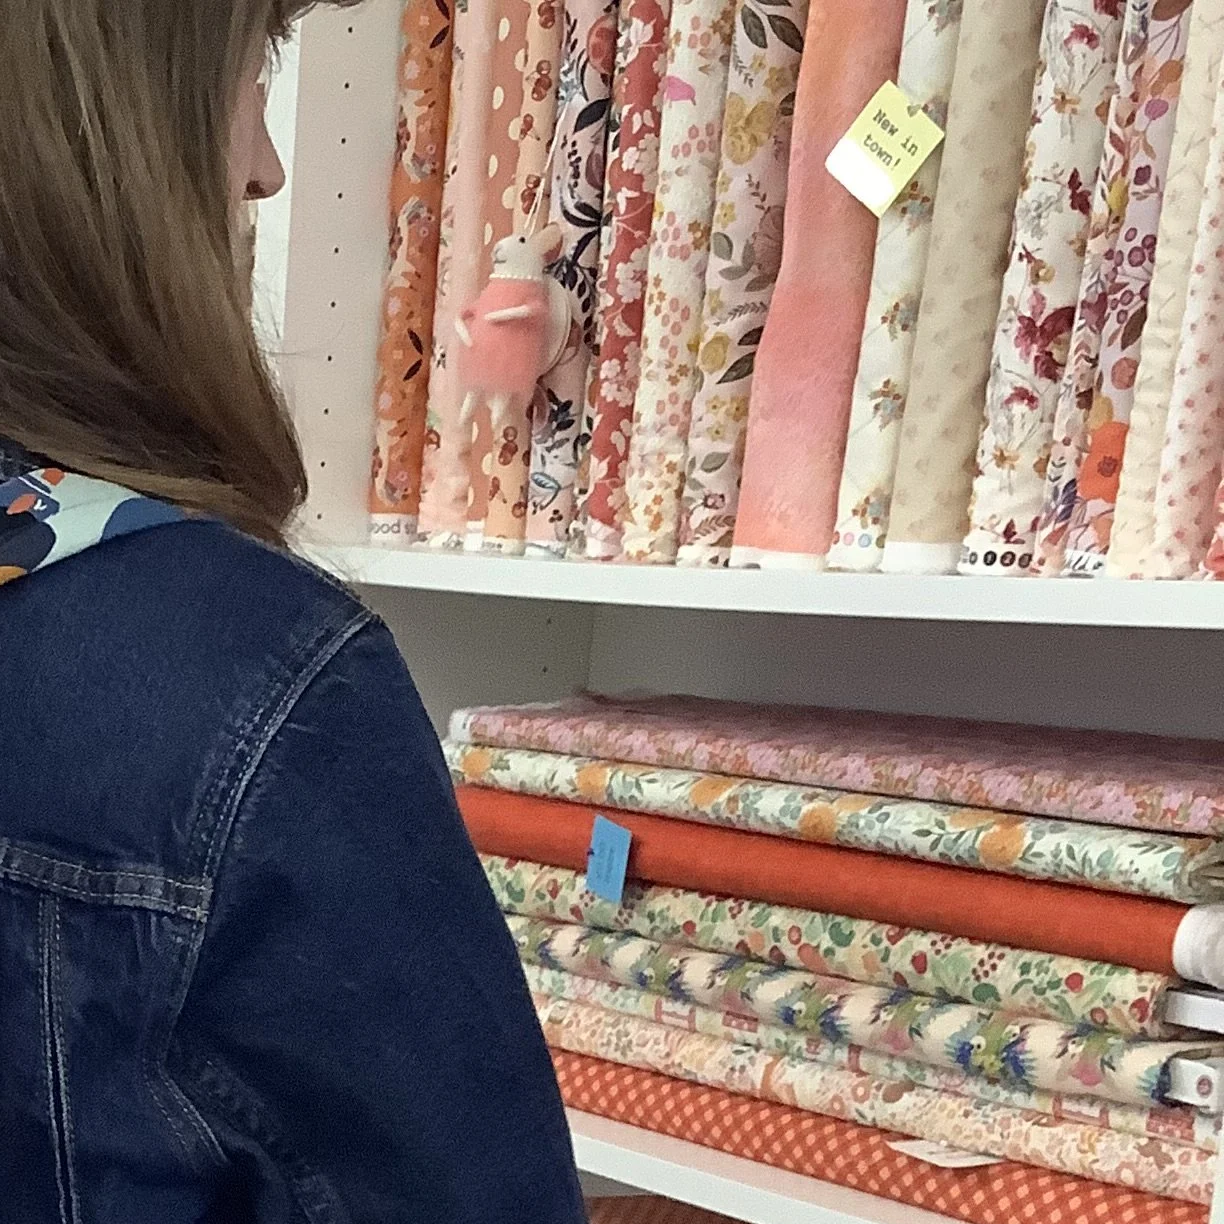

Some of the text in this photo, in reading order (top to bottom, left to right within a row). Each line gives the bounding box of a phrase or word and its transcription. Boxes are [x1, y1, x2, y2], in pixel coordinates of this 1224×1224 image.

[863, 133, 902, 171] town!
[873, 108, 919, 157] New in
